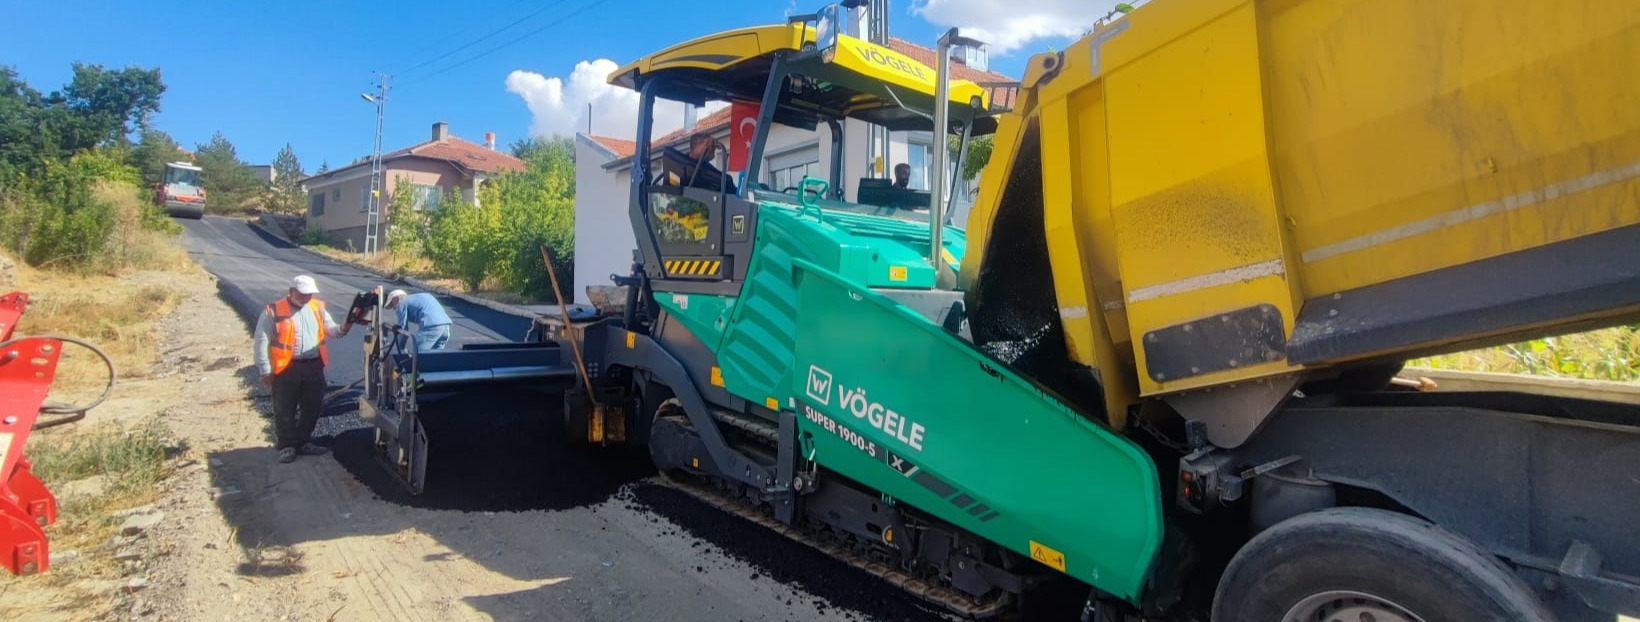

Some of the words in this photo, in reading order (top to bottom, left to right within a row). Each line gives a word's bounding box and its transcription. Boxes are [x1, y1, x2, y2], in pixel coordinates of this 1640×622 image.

[855, 46, 928, 81] VÖGELE
[805, 406, 836, 434] SUPER
[837, 425, 876, 457] 1900-5
[838, 384, 925, 451] VÖGELE
